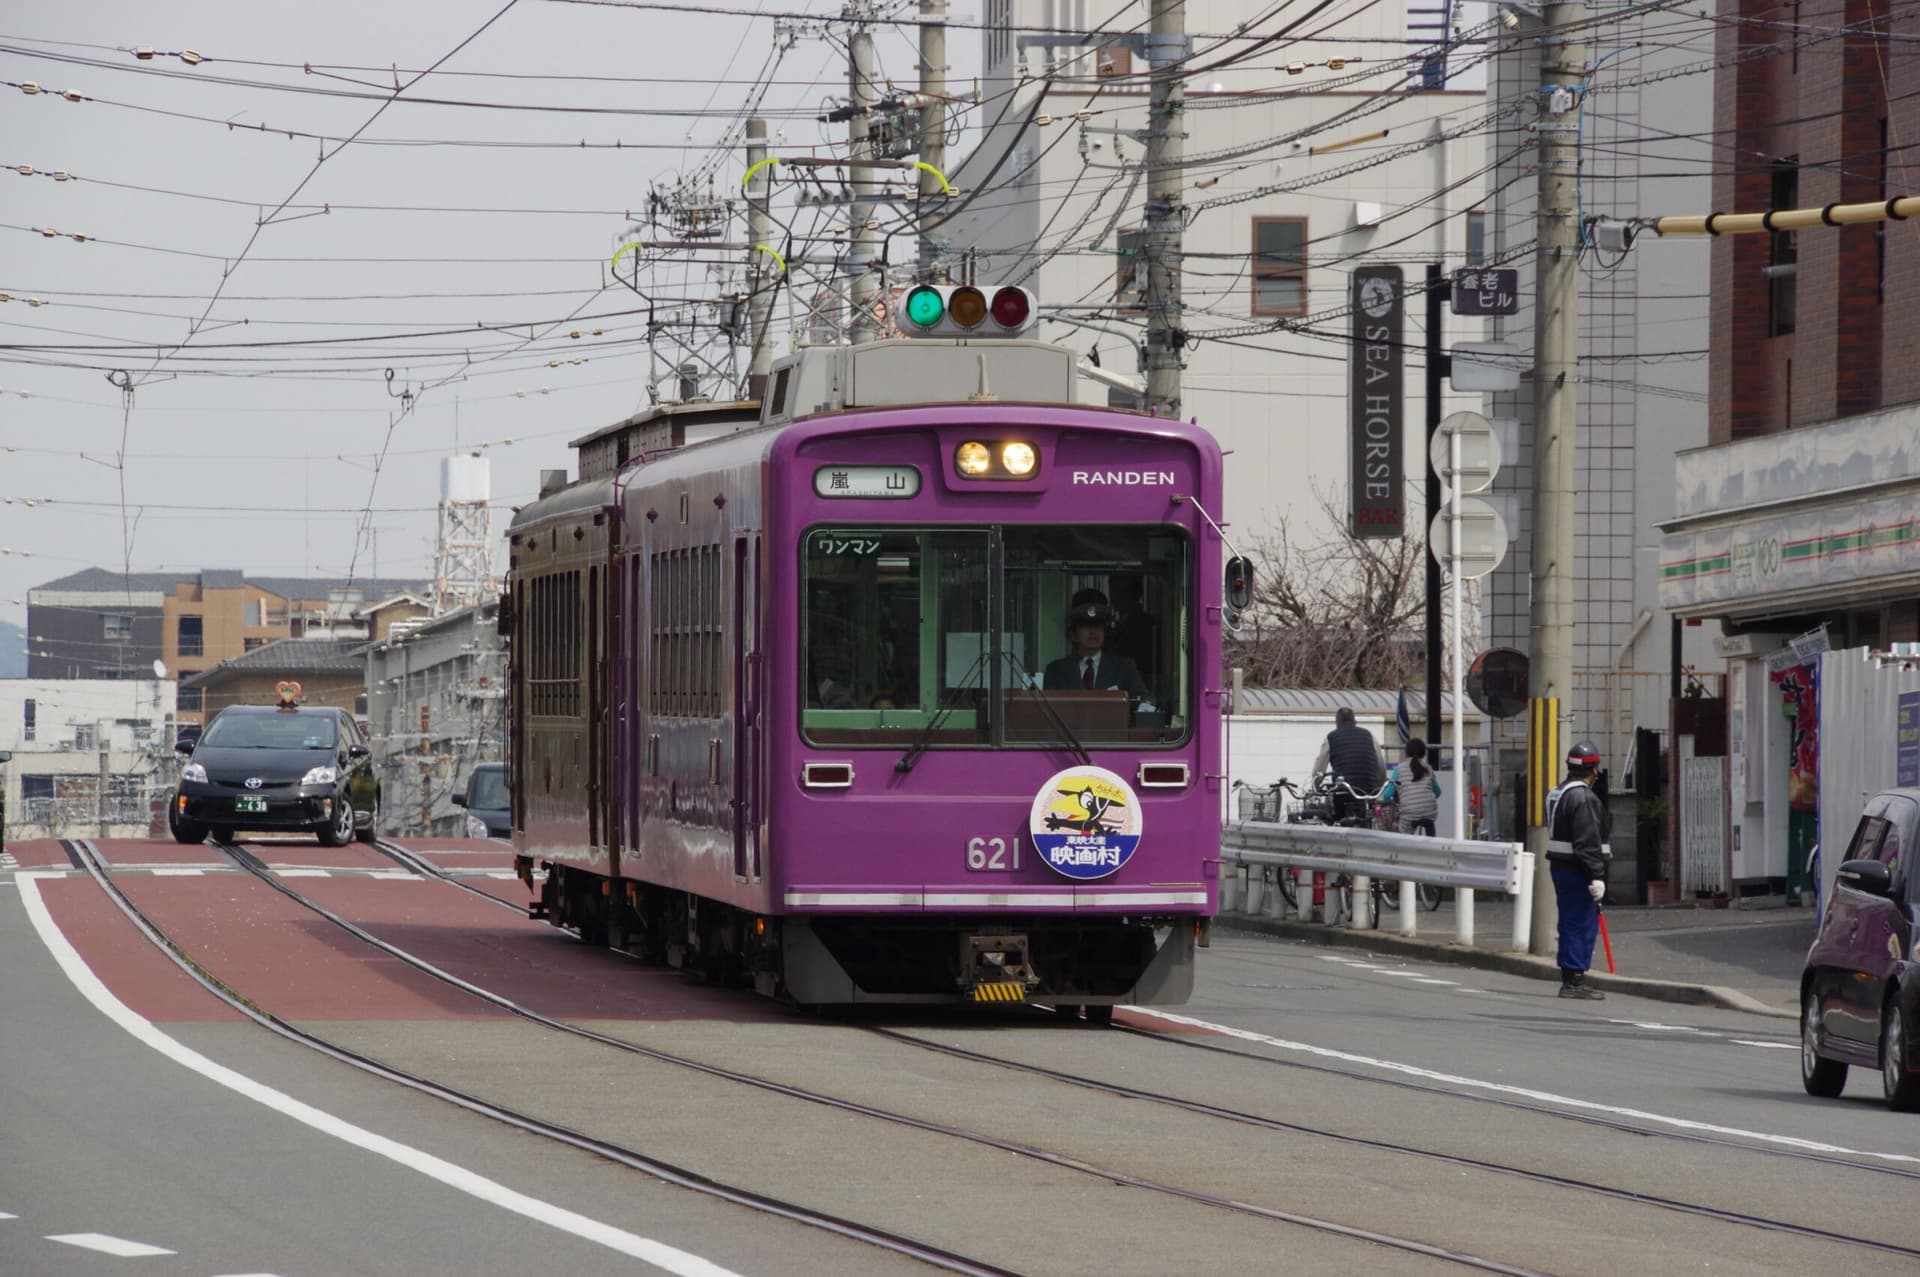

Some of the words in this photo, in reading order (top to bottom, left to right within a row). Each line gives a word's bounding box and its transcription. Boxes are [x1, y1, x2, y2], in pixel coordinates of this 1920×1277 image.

[1479, 291, 1513, 308] ビル
[1366, 325, 1390, 385] SEA
[1366, 394, 1390, 500] HORSE
[1072, 471, 1176, 486] RANDEN
[1358, 508, 1399, 526] BAR
[818, 538, 881, 556] ワンマン
[967, 837, 1020, 870] 621
[1050, 845, 1122, 866] 映画村
